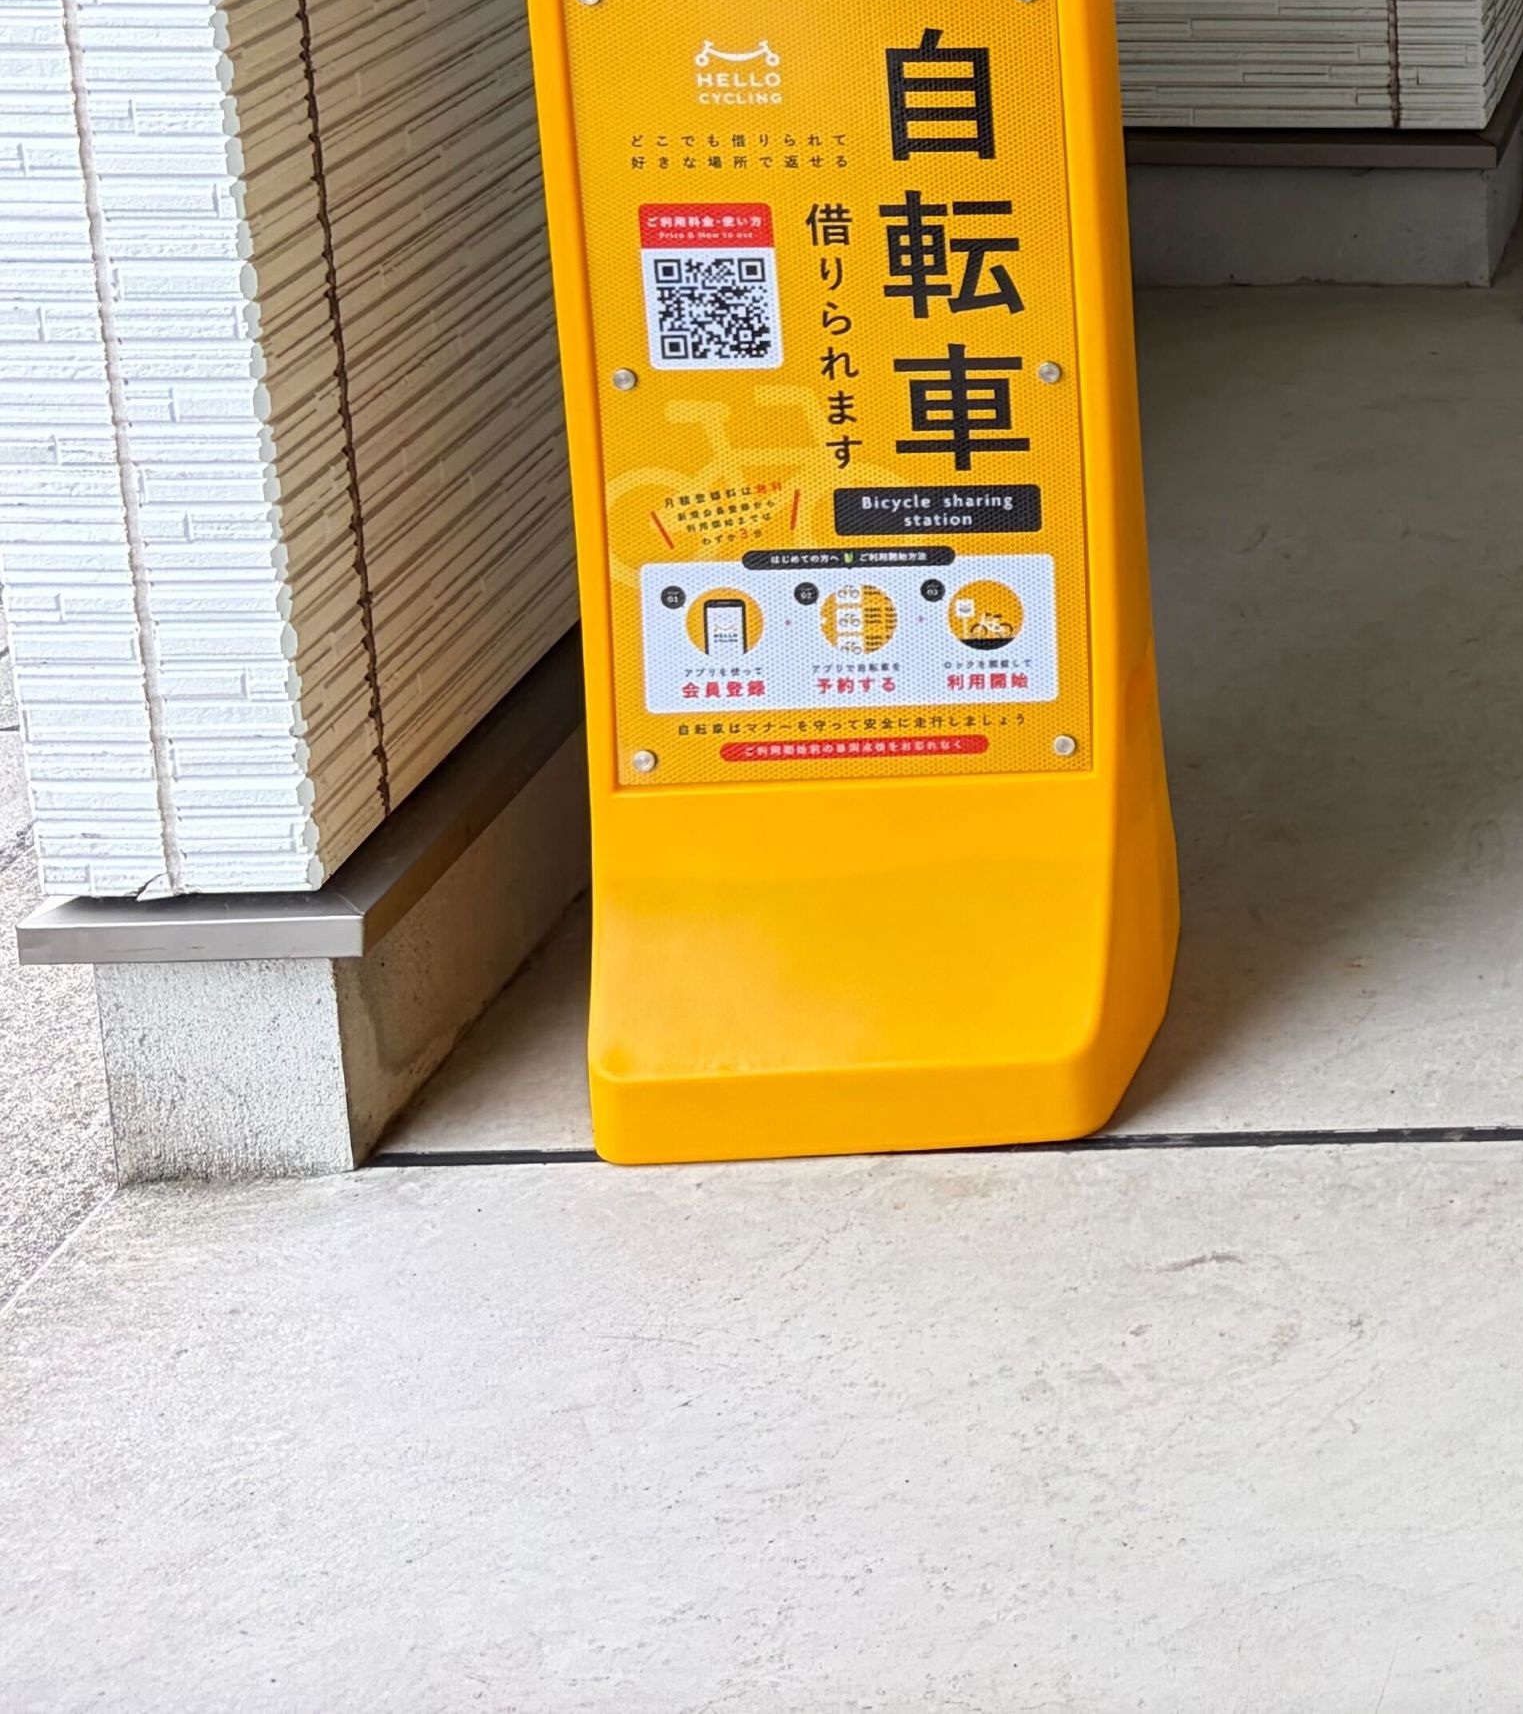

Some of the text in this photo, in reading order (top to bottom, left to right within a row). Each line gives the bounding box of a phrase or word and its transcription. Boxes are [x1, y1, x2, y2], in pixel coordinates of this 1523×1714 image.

[695, 73, 782, 87] HELLO
[699, 93, 783, 105] CYCLING
[631, 134, 847, 147] どこでも借りられて
[631, 155, 848, 169] 好きな場所で返せる
[879, 28, 1030, 471] 自転車
[805, 203, 862, 469] 借りられます
[862, 493, 1013, 512] Bicycle sharing
[903, 513, 973, 527] station
[682, 680, 766, 699] 会員登録
[816, 677, 896, 694] 予約する
[947, 672, 1028, 690] 利用開始
